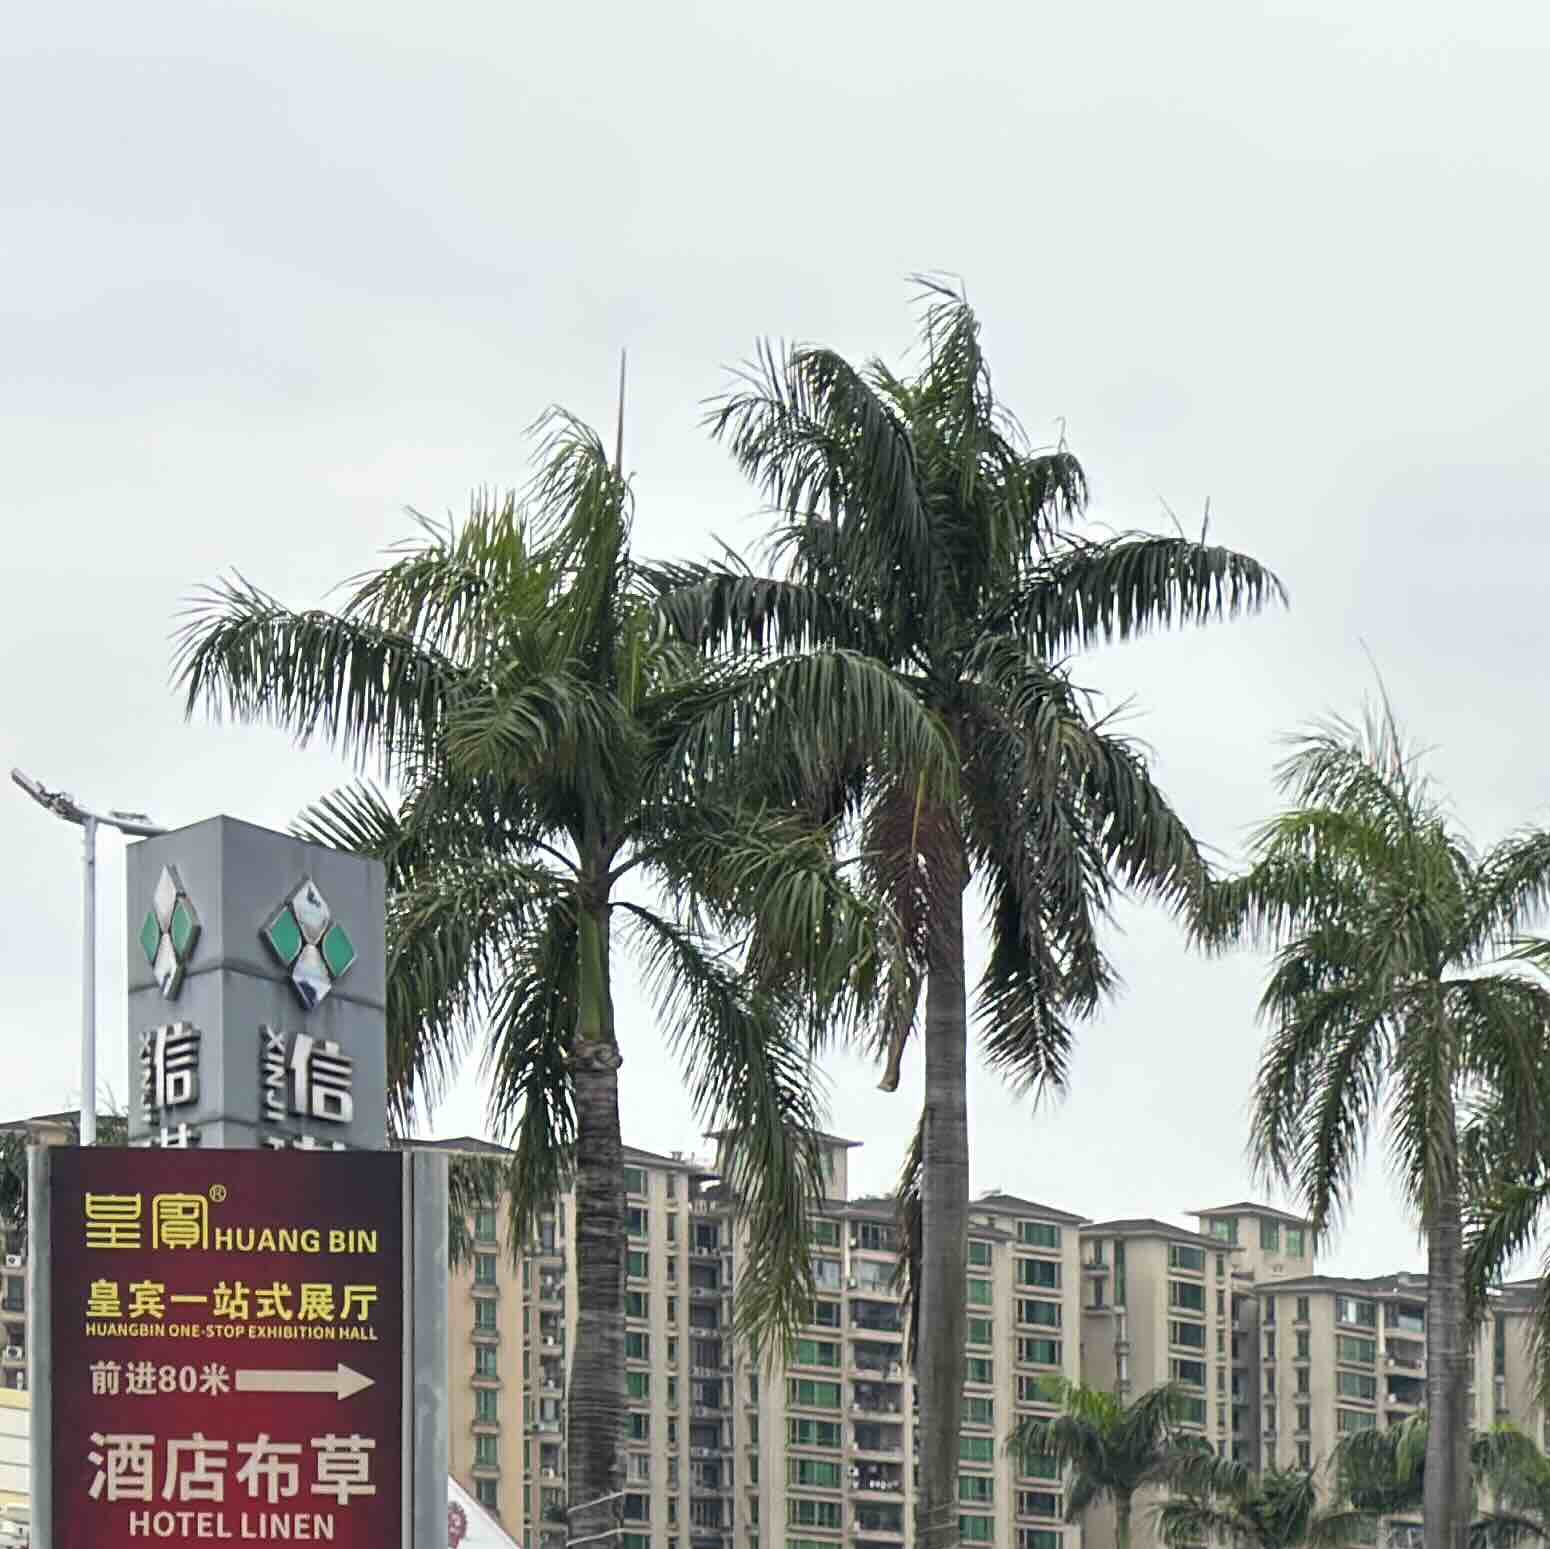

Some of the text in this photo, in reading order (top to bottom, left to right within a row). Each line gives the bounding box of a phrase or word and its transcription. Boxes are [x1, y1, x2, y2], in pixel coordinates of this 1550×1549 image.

[152, 1022, 200, 1148] 信
[289, 1032, 353, 1149] 信
[215, 1228, 321, 1253] HUANG
[328, 1229, 378, 1253] BIN
[85, 1278, 379, 1322] 皇宾一站式展厅
[85, 1322, 379, 1341] HUANGBIN ONE-STOP EXHIBITION HALL
[89, 1360, 231, 1396] 前进80米
[87, 1431, 377, 1506] 酒店布草
[129, 1511, 335, 1540] HOTEL LINEN
